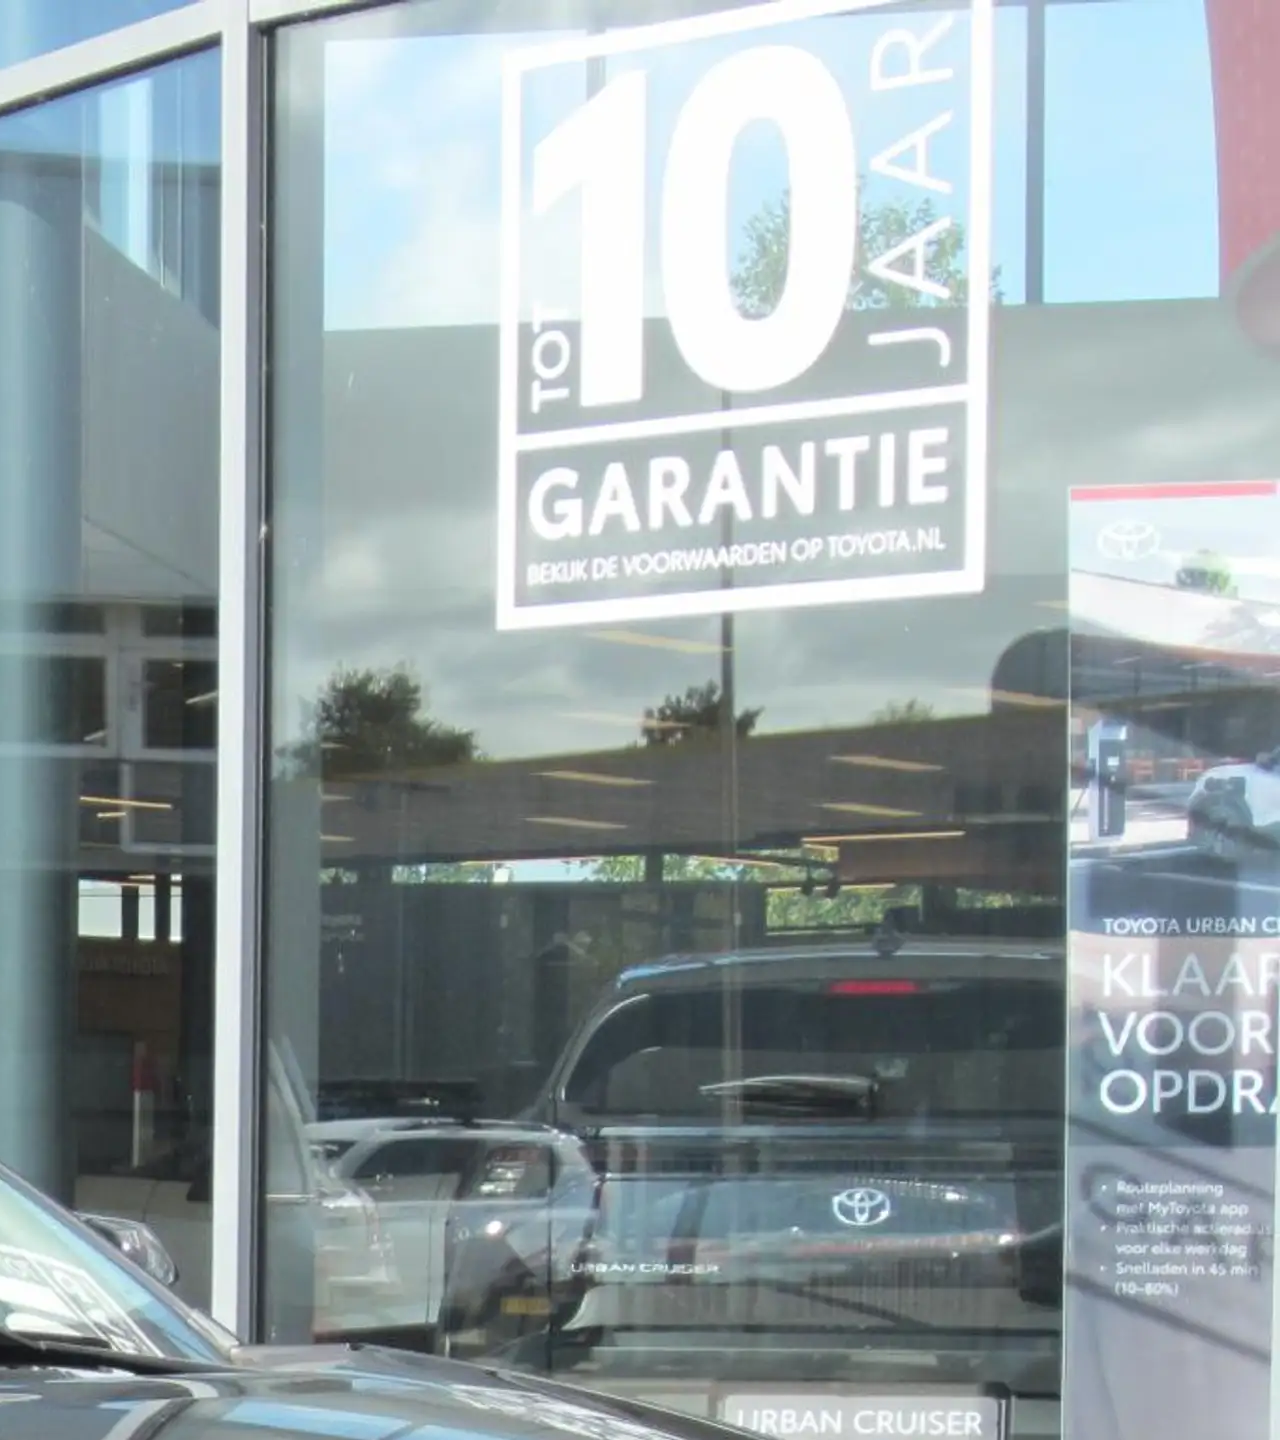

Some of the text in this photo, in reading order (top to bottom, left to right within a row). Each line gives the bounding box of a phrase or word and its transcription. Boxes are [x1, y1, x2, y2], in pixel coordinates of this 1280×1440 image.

[867, 14, 954, 367] JAAR
[533, 44, 857, 407] 10
[531, 301, 570, 414] TOT
[528, 428, 948, 541] GARANTIE
[592, 555, 619, 581] DE
[621, 541, 787, 577] VOORWAARDEN
[791, 537, 824, 562] OP
[827, 526, 947, 560] TOYOTA.NL
[1102, 916, 1181, 935] TOYOTA
[1186, 916, 1256, 934] URBAN
[1098, 1011, 1273, 1056] VOOR
[1100, 1069, 1279, 1115] OPDR
[1220, 1203, 1249, 1217] app
[571, 1262, 635, 1274] URBAN
[1115, 1261, 1189, 1275] Snelladen
[1192, 1261, 1205, 1275] in
[737, 1409, 983, 1436] URBAN CRUISER
